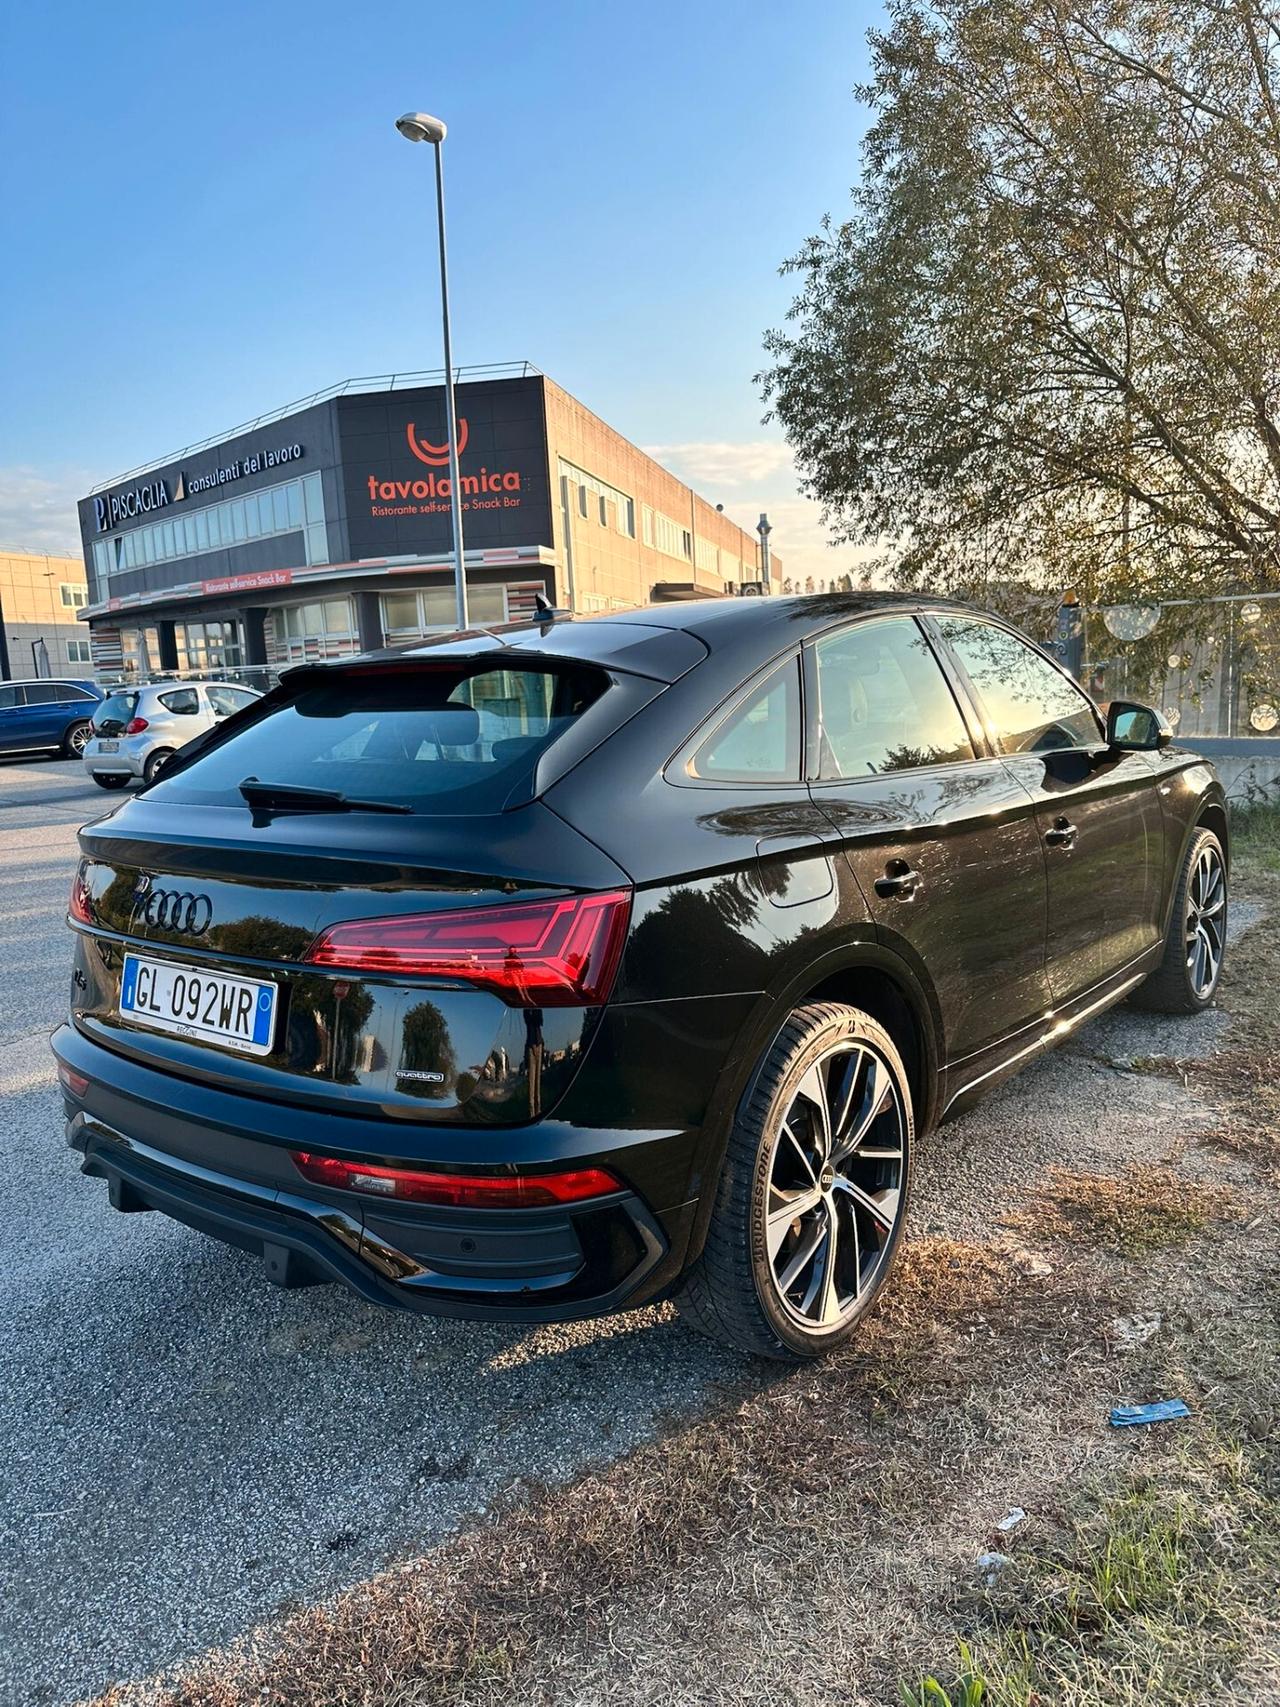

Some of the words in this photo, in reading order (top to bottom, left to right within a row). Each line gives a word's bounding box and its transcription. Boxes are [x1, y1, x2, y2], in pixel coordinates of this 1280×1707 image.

[188, 461, 240, 494] consulenti
[243, 454, 261, 474] del
[264, 444, 301, 468] lavoro
[368, 467, 520, 500] tavolamica
[111, 480, 168, 522] PISCAGLIA
[372, 504, 417, 517] Ristorante
[472, 498, 501, 510] Snack
[503, 496, 521, 507] Bar
[136, 966, 161, 1013] GL
[171, 974, 253, 1035] 092WR
[395, 1071, 441, 1080] quattro
